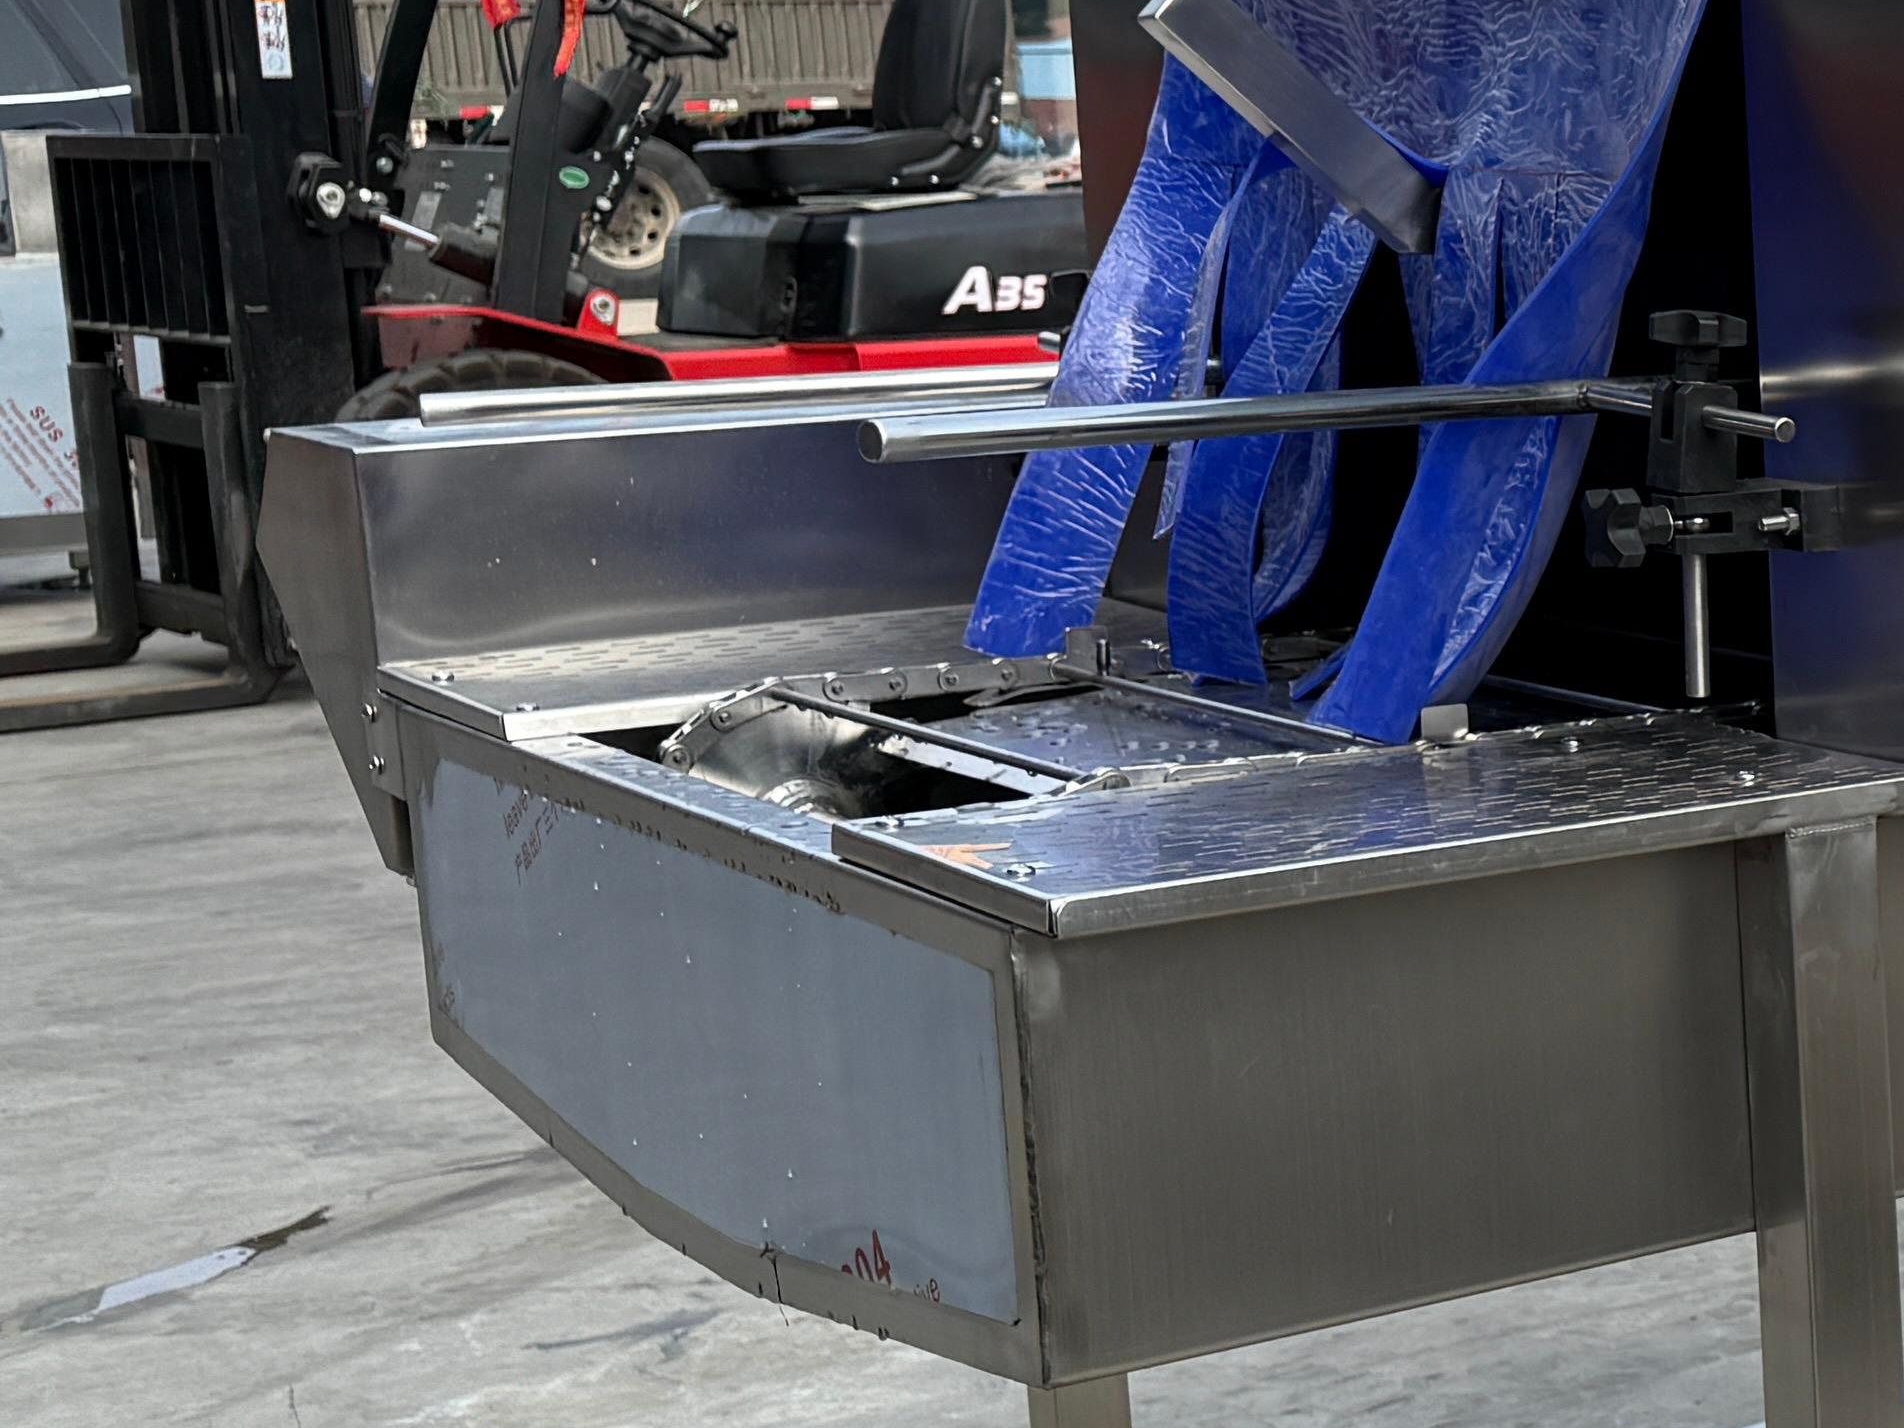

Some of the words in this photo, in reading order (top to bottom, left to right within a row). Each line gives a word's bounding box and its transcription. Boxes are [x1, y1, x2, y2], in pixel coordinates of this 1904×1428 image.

[942, 266, 1047, 315] A35
[30, 406, 64, 442] SUS
[842, 1230, 892, 1286] 04
